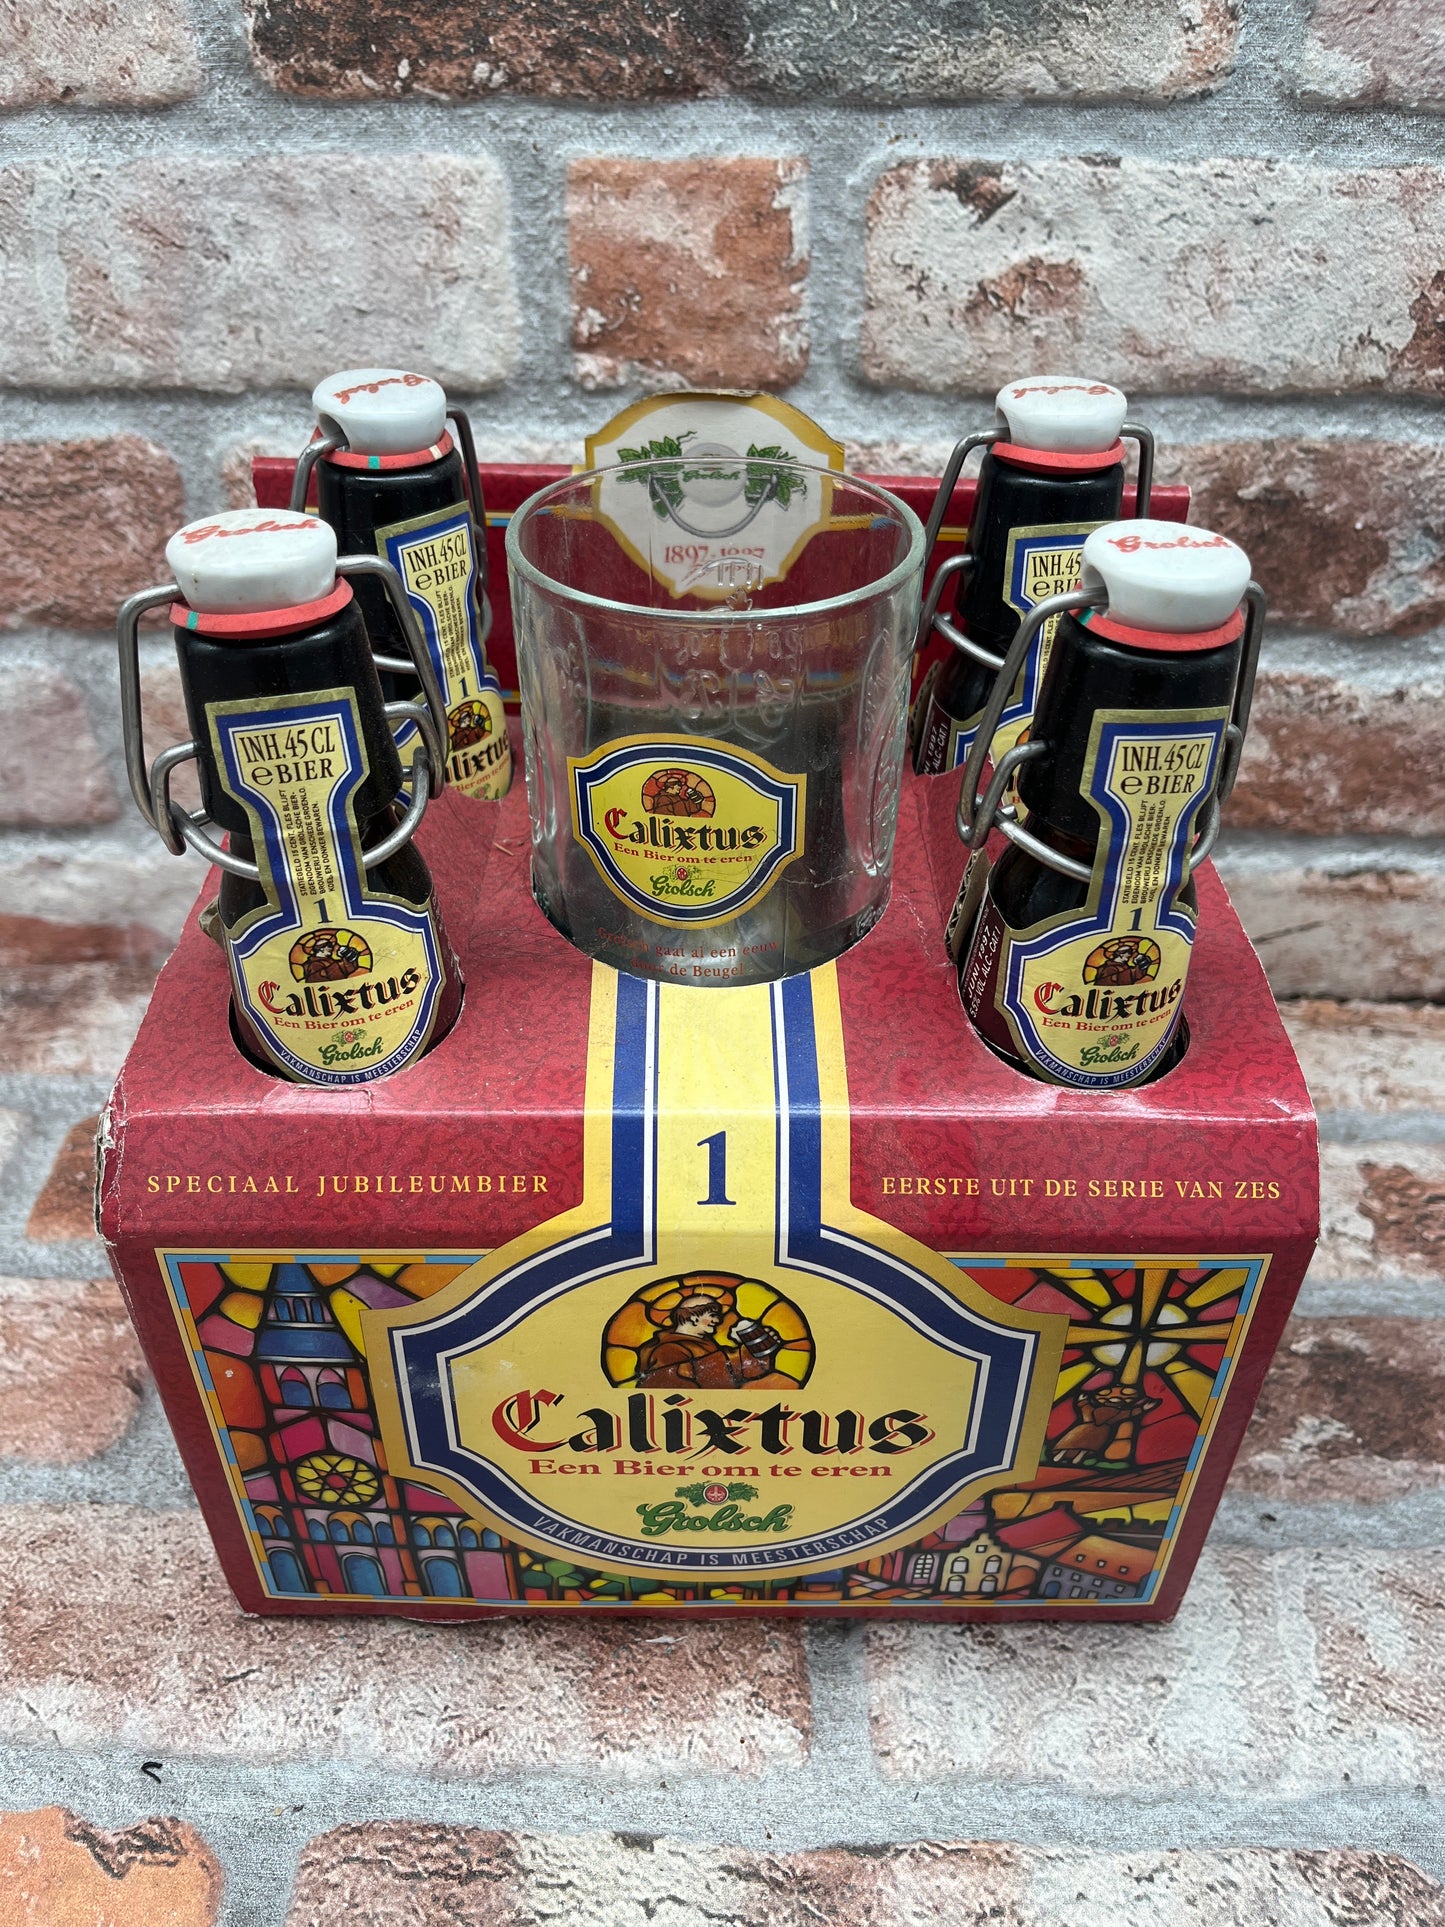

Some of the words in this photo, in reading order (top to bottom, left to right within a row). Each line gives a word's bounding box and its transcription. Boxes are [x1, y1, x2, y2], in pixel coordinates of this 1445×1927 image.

[180, 518, 319, 544] Grolsch
[1107, 535, 1232, 552] Grolsch
[433, 560, 467, 586] BIER
[459, 676, 470, 699] 1
[274, 758, 334, 784] BIER
[1145, 774, 1195, 795] BIER
[279, 789, 290, 811] BLIJFT
[1138, 800, 1148, 822] BLIJFT
[284, 814, 293, 830] FLES
[294, 812, 306, 846] GROLSCHE
[604, 807, 768, 854] Calixtus
[1135, 823, 1144, 840] FLES
[305, 821, 318, 854] ENSCHEDE
[318, 836, 330, 864] DONKER
[301, 847, 309, 860] VAN
[614, 842, 639, 857] Een
[643, 848, 675, 862] Bier
[677, 855, 700, 864] om
[703, 855, 718, 864] te
[720, 855, 753, 864] eren
[1136, 856, 1144, 869] VAN
[294, 859, 307, 896] STATIEGELD
[304, 861, 317, 895] EIGENDOM
[313, 856, 326, 894] BROUWERIJ
[324, 865, 332, 874] EN
[1152, 877, 1158, 887] EN
[650, 875, 716, 897] Grolsch
[313, 898, 332, 924] 1
[1127, 907, 1145, 932] 1
[655, 945, 685, 958] gaat
[710, 947, 737, 958] een
[742, 941, 778, 956] eeuw
[968, 962, 980, 999] JUNI
[978, 925, 991, 959] 1997
[669, 963, 687, 976] de
[693, 962, 744, 980] Beugel
[257, 967, 422, 1020] Calixtus
[1033, 978, 1182, 1023] Calixtus
[273, 1016, 300, 1029] Een
[305, 1020, 338, 1030] Bier
[341, 1018, 365, 1028] om
[369, 1013, 382, 1022] te
[385, 999, 414, 1016] eren
[1042, 1017, 1071, 1029] Een
[1075, 1022, 1110, 1032] Bier
[1111, 1023, 1133, 1031] om
[1136, 1019, 1146, 1027] te
[1149, 1008, 1171, 1024] eren
[280, 1049, 347, 1084] VAKMANSCHAP
[351, 1075, 361, 1083] IS
[364, 1028, 422, 1080] MEESTERSCHAP
[318, 1037, 384, 1065] Grolsch
[1035, 1049, 1097, 1085] VAKMANSCHAP
[1100, 1077, 1109, 1085] IS
[1112, 1037, 1167, 1083] MEESTERSCHAP
[1079, 1043, 1140, 1066] Grolsch
[696, 1130, 736, 1206] 1
[147, 1174, 300, 1194] SPECIAAL
[317, 1174, 548, 1197] JUBILEUMBIER
[881, 1176, 981, 1196] EERSTE
[990, 1177, 1034, 1196] UIT
[1044, 1179, 1078, 1197] DE
[1088, 1179, 1165, 1198] SERIE
[1174, 1180, 1224, 1198] VAN
[1234, 1181, 1281, 1199] ZES
[491, 1388, 937, 1461] Calixtus
[527, 1459, 600, 1475] Een
[613, 1459, 695, 1476] Bier
[701, 1463, 758, 1477] om
[768, 1463, 802, 1477] te
[810, 1463, 892, 1477] eren
[636, 1501, 794, 1536] Grolsch
[532, 1515, 688, 1564] VAKMANSCHAP
[700, 1553, 719, 1565] IS
[731, 1517, 889, 1565] MEESTERSCHAP
